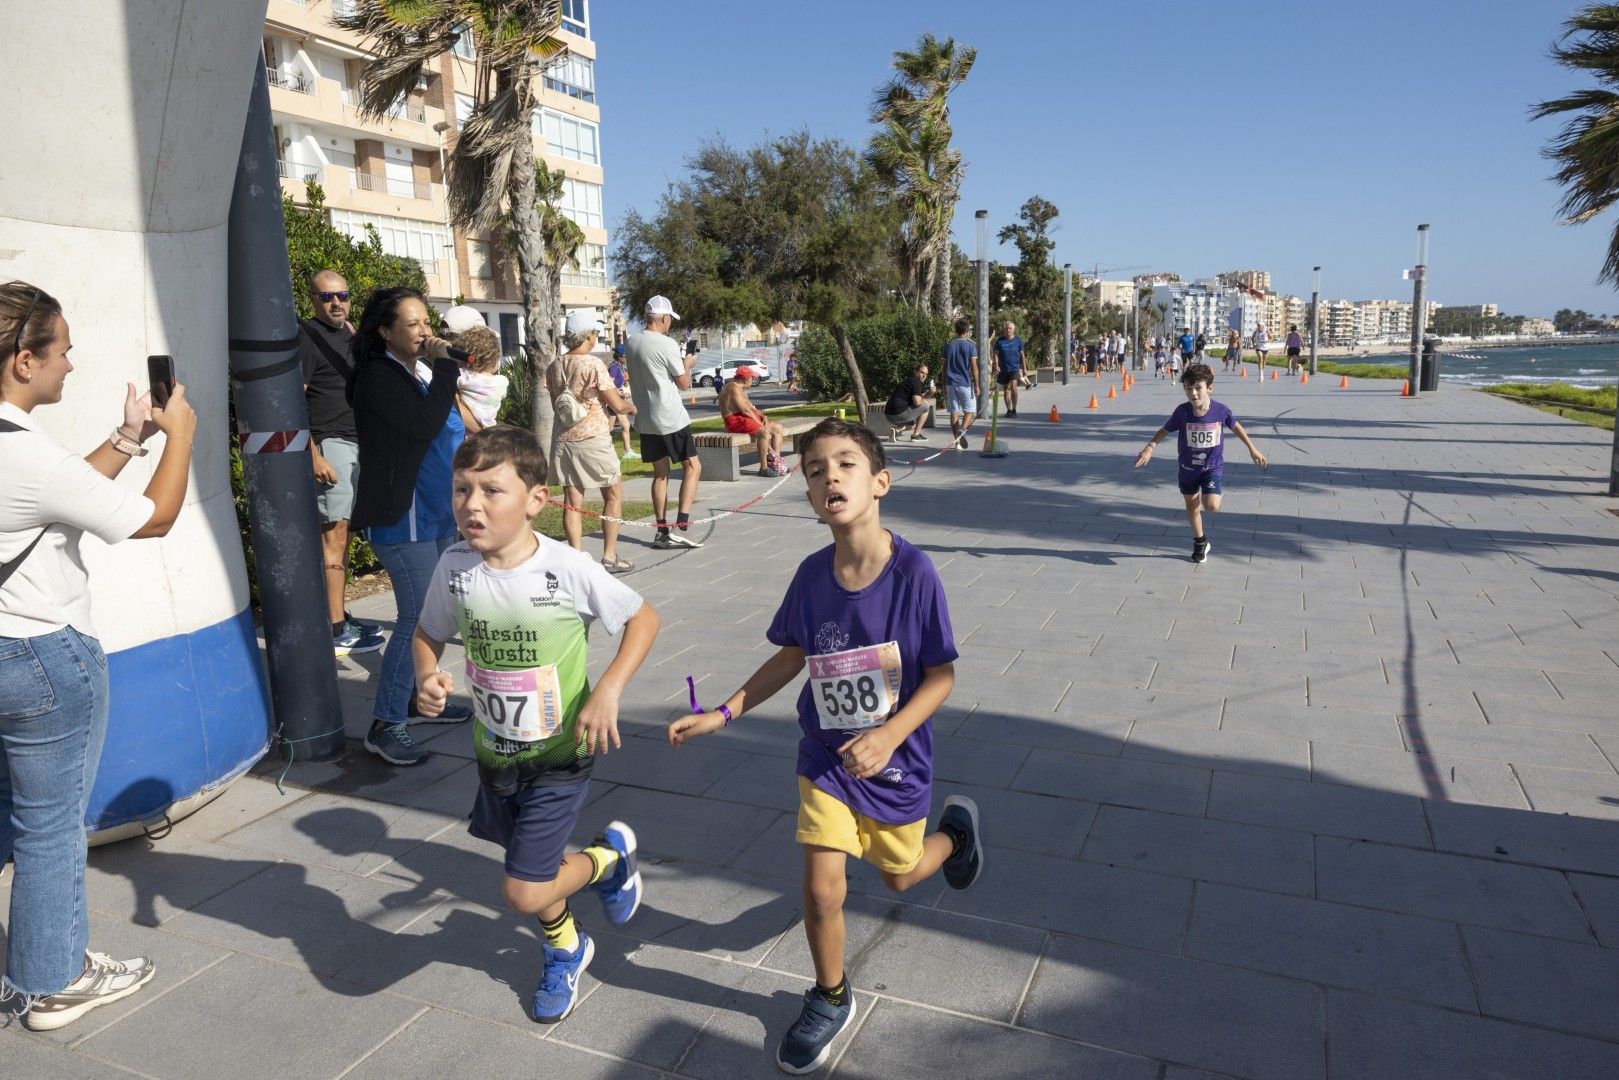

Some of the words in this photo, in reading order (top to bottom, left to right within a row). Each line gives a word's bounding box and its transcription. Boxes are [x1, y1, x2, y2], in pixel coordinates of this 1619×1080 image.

[1191, 431, 1213, 444] 505
[464, 608, 473, 620] El
[468, 619, 538, 642] Mesón
[480, 642, 537, 665] Costa
[471, 684, 528, 728] 507
[821, 675, 880, 717] 538
[543, 689, 556, 732] INFANTIL
